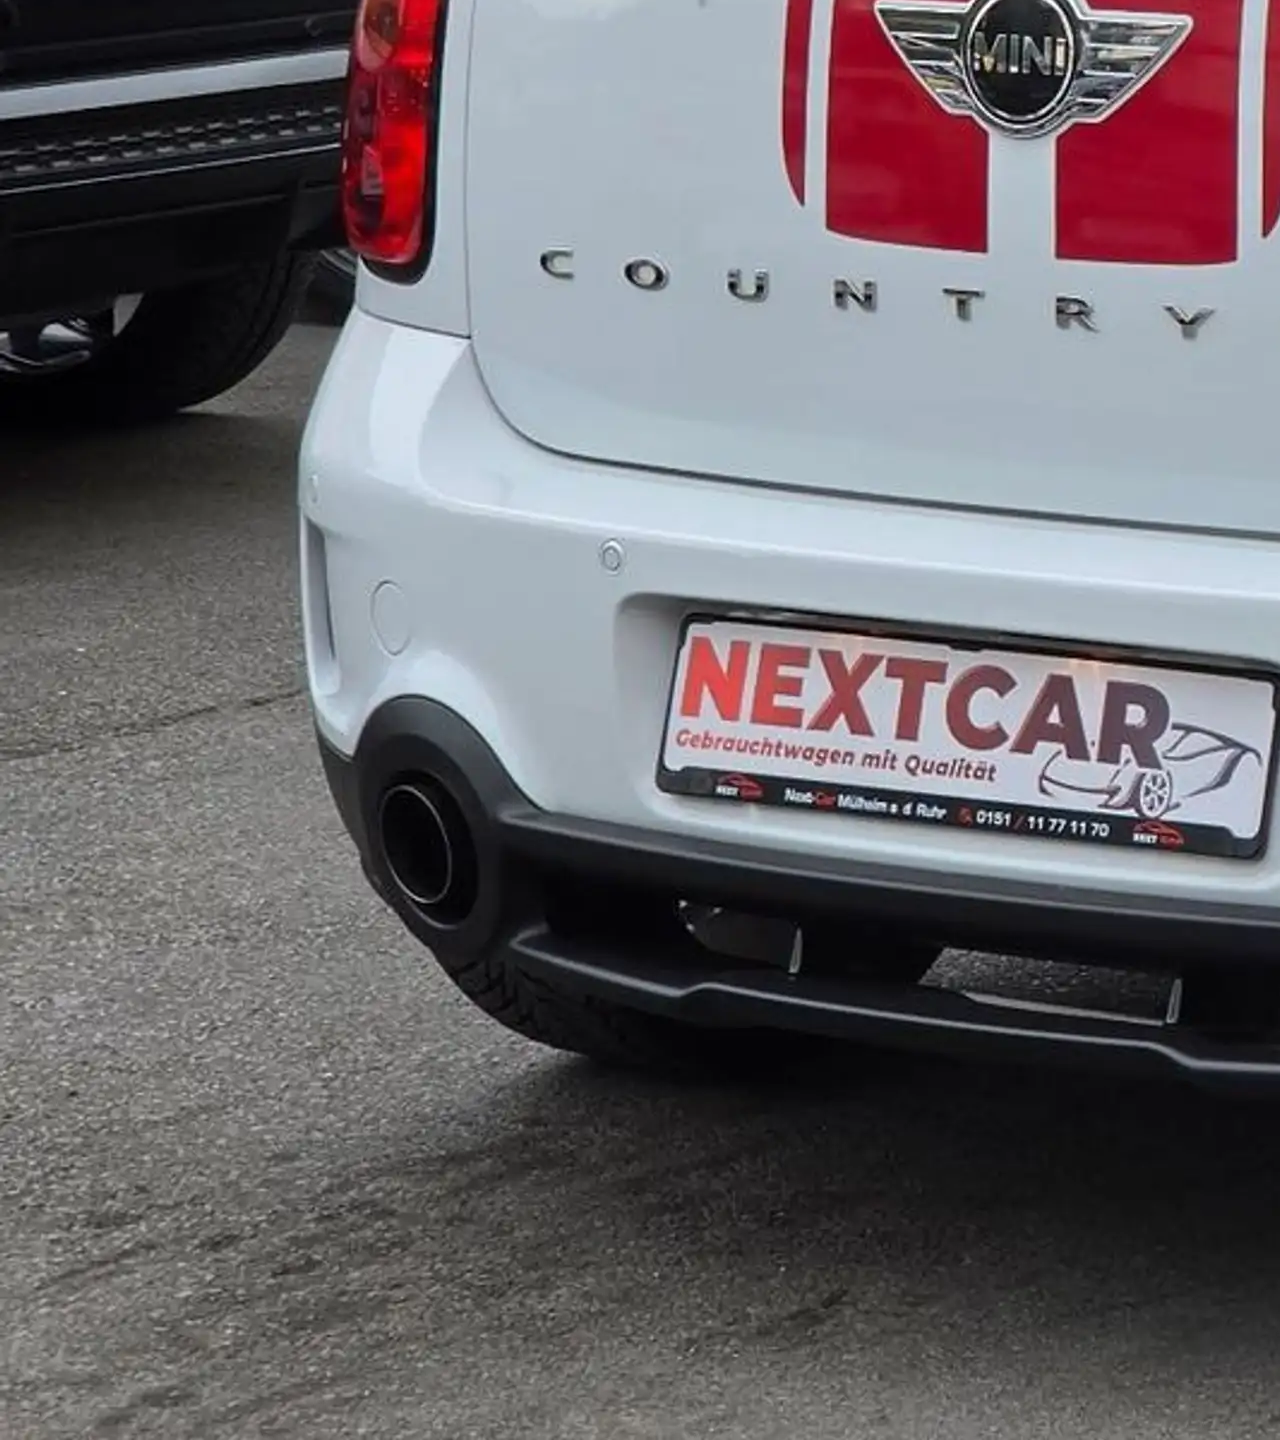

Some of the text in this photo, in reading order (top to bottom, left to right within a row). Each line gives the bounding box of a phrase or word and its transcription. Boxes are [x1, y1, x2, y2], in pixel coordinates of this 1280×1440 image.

[972, 30, 1068, 76] MINI
[680, 636, 1170, 770] NEXTCAR
[676, 728, 998, 783] Gebrauchtwagen mit Qualität
[976, 810, 1011, 827] 0151
[1028, 816, 1044, 830] 11
[1049, 817, 1067, 833] 77
[1071, 820, 1086, 835] 11
[1091, 821, 1110, 837] 70
